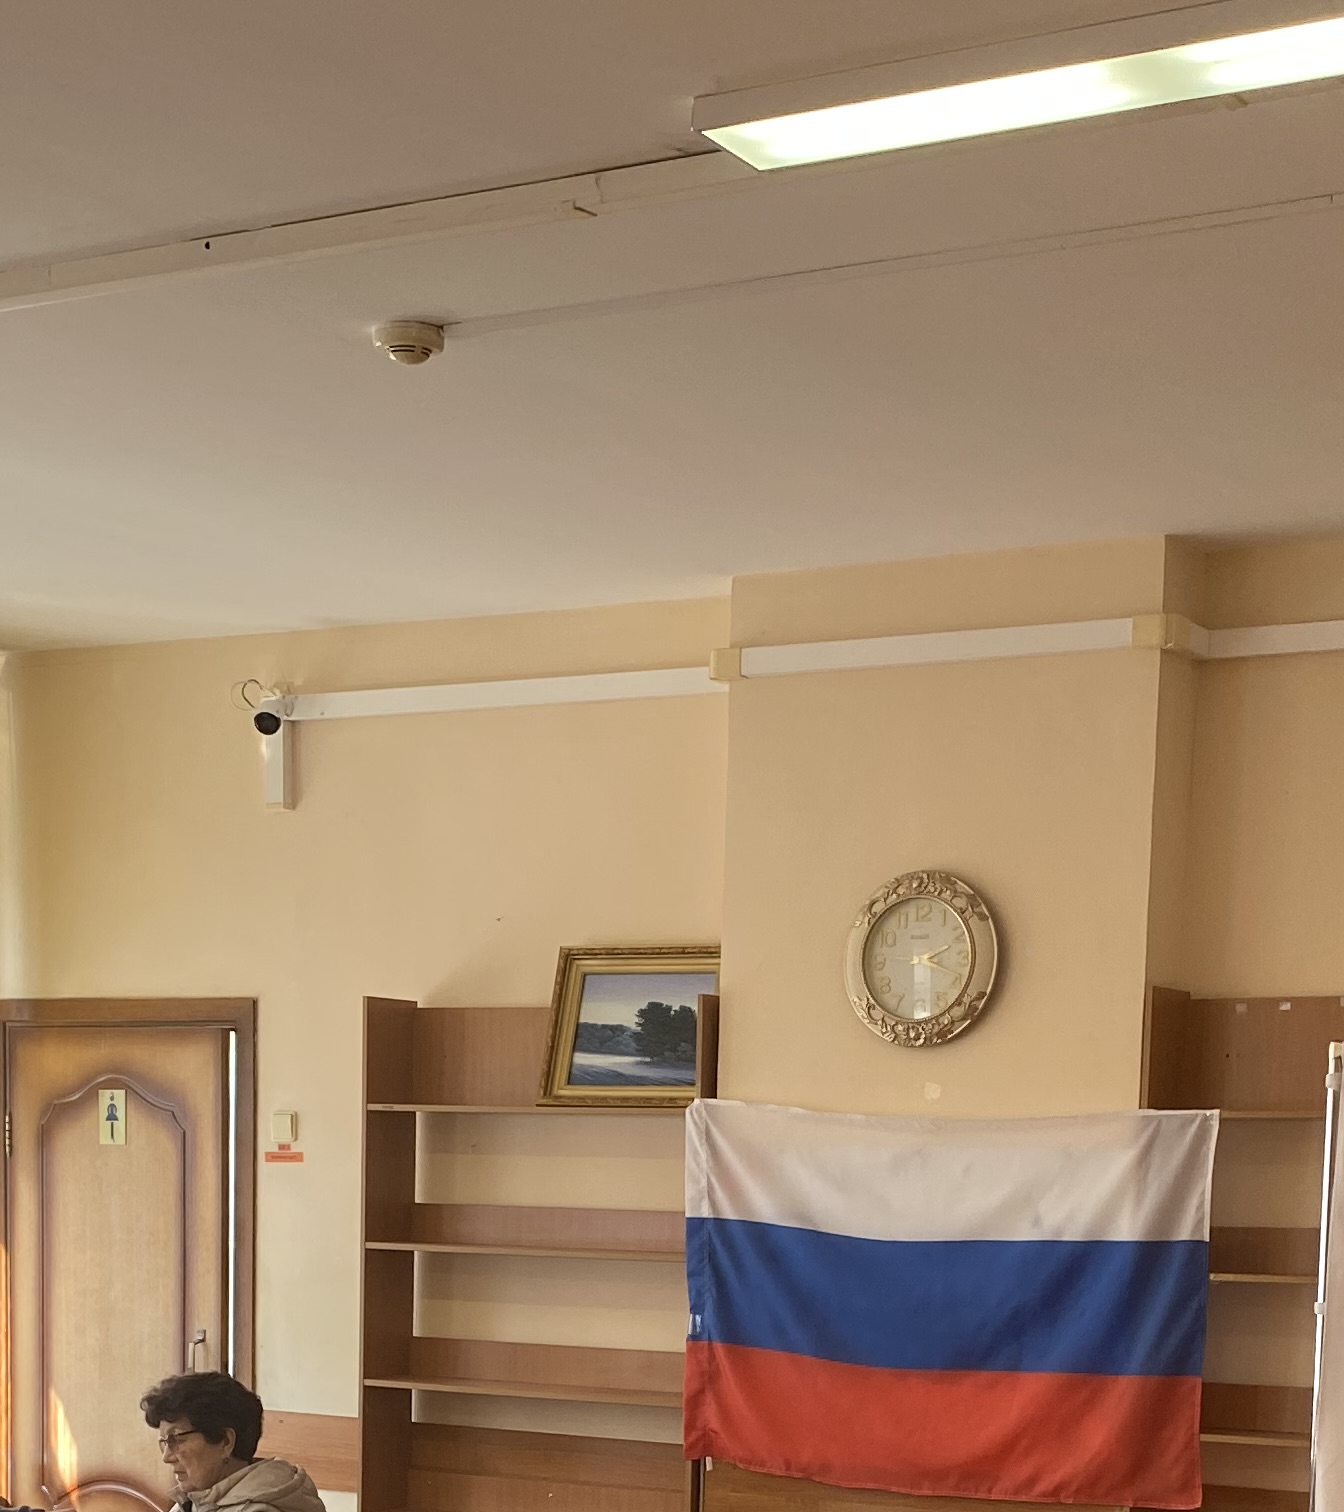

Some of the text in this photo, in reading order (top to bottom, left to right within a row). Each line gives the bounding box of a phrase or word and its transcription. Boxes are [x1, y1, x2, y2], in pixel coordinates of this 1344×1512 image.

[897, 911, 909, 929] 11
[915, 903, 932, 922] 12
[879, 929, 896, 948] 10
[879, 976, 891, 994] 8
